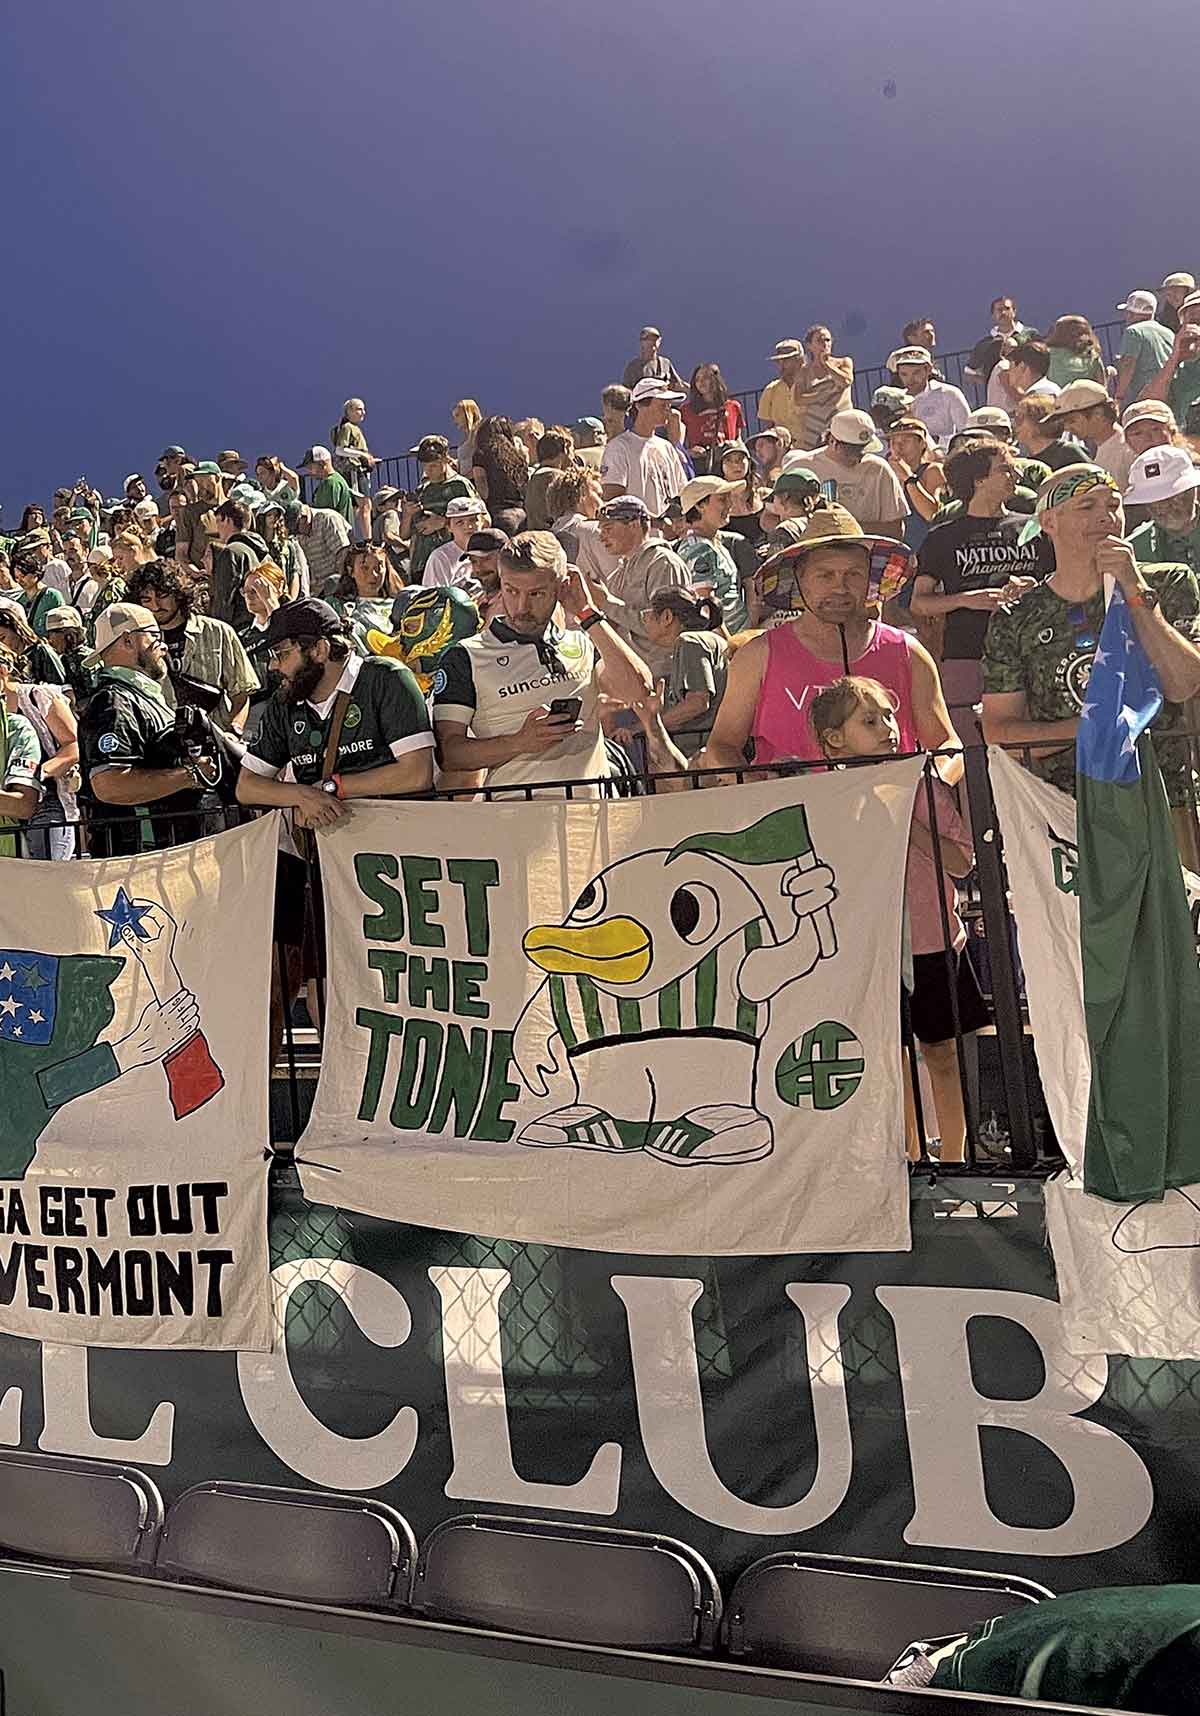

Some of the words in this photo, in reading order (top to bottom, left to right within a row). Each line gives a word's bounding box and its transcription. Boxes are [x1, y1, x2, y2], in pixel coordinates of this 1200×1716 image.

[955, 545, 1040, 566] NATIONAL
[1055, 652, 1077, 684] ZERO
[353, 852, 500, 957] SET
[367, 949, 490, 1019] THE
[356, 1007, 521, 1143] TONE
[38, 1185, 116, 1237] GET
[126, 1181, 228, 1237] OUT
[235, 1257, 1156, 1557] CLUB
